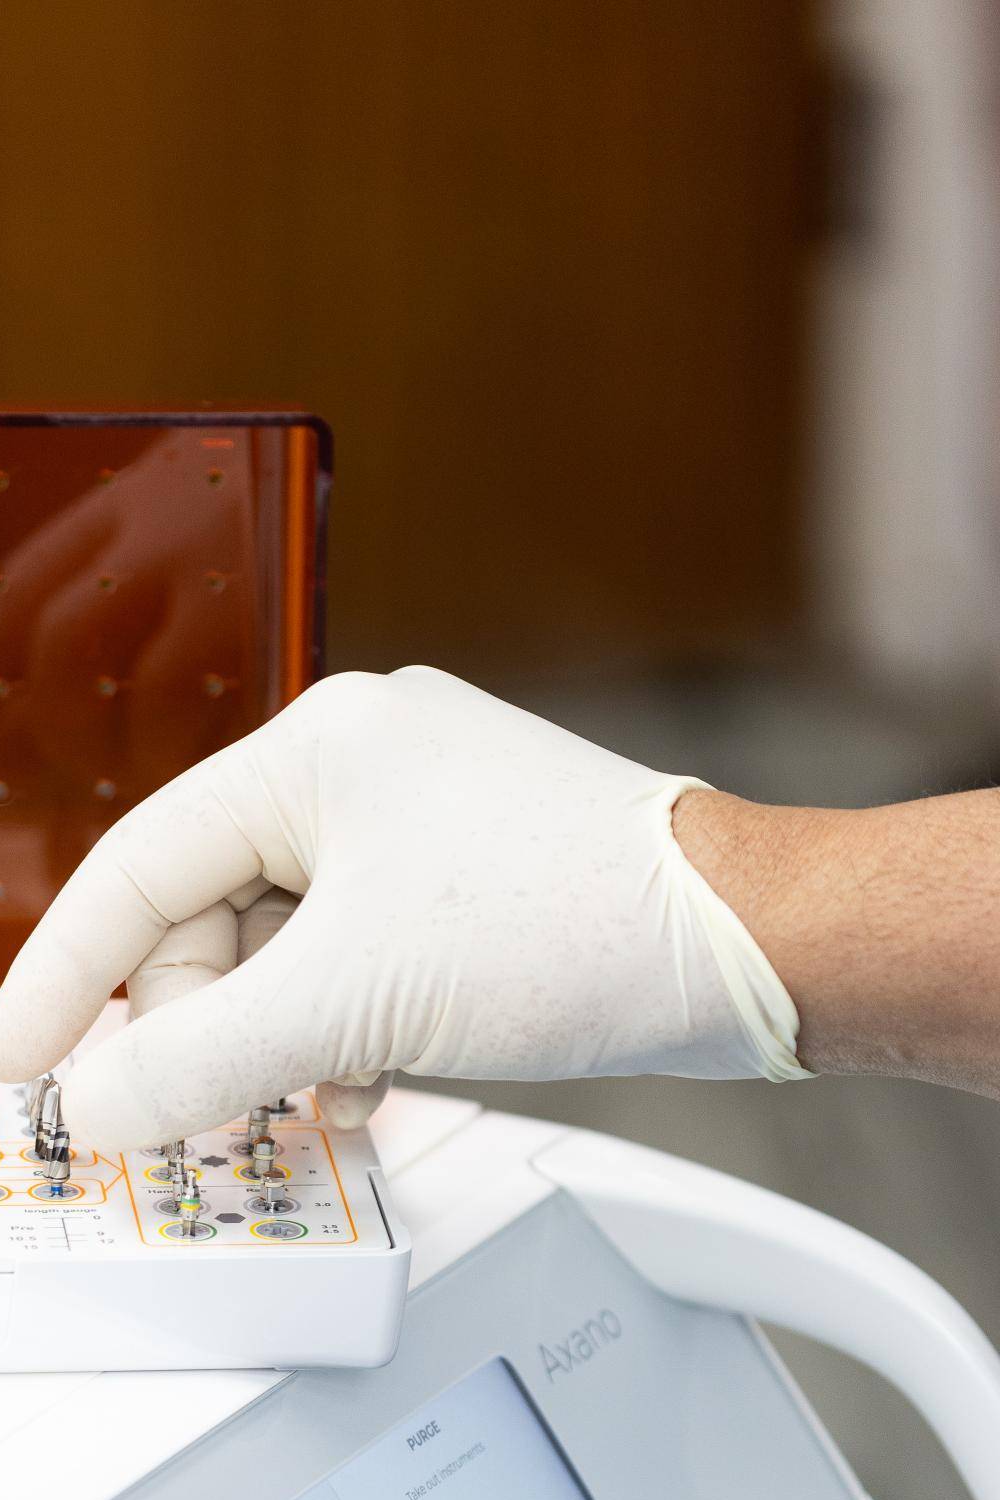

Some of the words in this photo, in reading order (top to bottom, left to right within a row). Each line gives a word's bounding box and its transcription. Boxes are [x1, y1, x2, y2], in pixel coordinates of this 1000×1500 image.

[537, 1308, 622, 1384] Axano
[406, 1420, 441, 1451] PURGE
[425, 1474, 441, 1490] out
[440, 1441, 486, 1481] instruments
